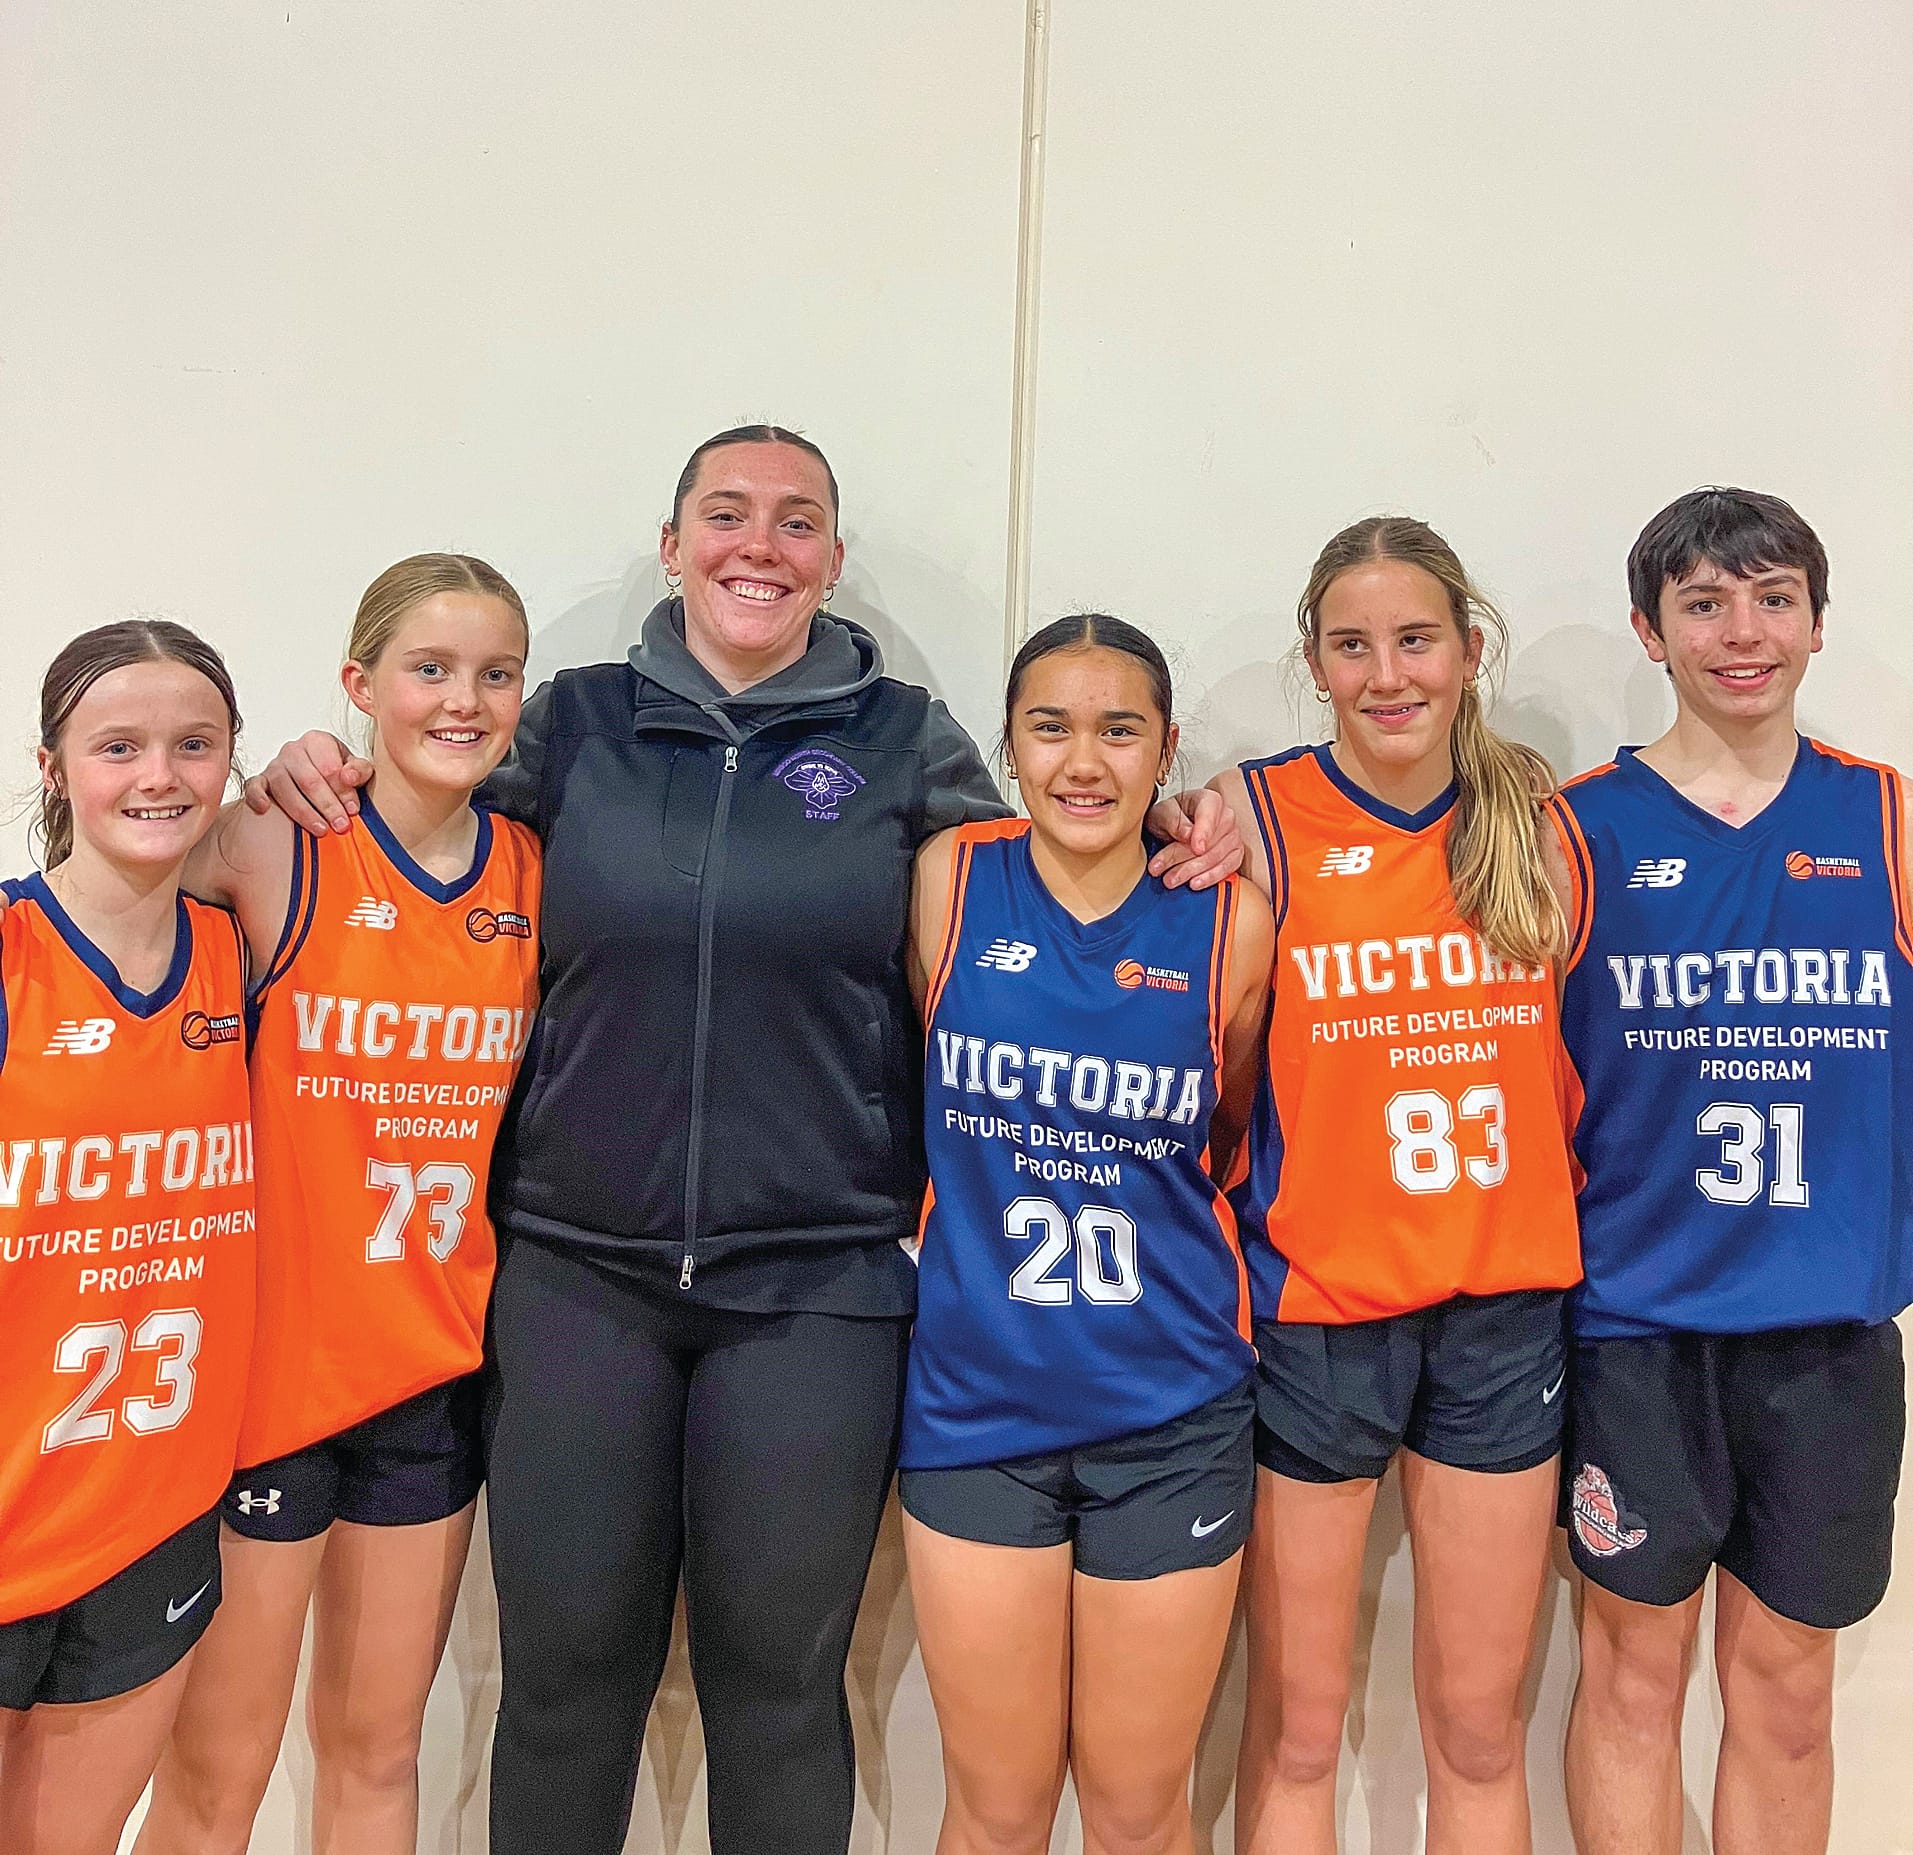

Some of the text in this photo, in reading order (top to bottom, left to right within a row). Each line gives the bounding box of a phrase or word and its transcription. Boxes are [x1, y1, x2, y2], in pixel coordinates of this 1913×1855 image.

[805, 810, 840, 820] STAFF
[1815, 857, 1860, 866] BASKETBALL
[1816, 865, 1862, 877] VICTORIA
[1146, 966, 1189, 980] BASKETBALL
[1146, 975, 1189, 992] VICTORIA
[1290, 931, 1546, 1001] VICTOR
[1607, 948, 1892, 1009] VICTORIA
[292, 989, 536, 1063] VICTORI
[1311, 1003, 1543, 1043] FUTURE DEVELOPMEN
[1624, 1026, 1889, 1050] FUTURE DEVELOPMENT
[1389, 1039, 1498, 1069] PROGRAM
[1700, 1059, 1811, 1081] PROGRAM
[297, 1075, 509, 1106] FUTURE DEVELOPM
[936, 1029, 1203, 1125] VICTORIA
[375, 1117, 478, 1140] PROGRAM
[945, 1108, 1185, 1161] FUTURE DEVELOPMENT
[1384, 1083, 1509, 1194] 83
[1014, 1152, 1121, 1186] PROGRAM
[1695, 1102, 1810, 1208] 31
[365, 1157, 476, 1264] 73
[0, 1208, 256, 1263] UTURE DEVELOPMEN
[1003, 1195, 1143, 1306] 20
[79, 1255, 205, 1294] PROGRAM
[40, 1306, 203, 1454] 23
